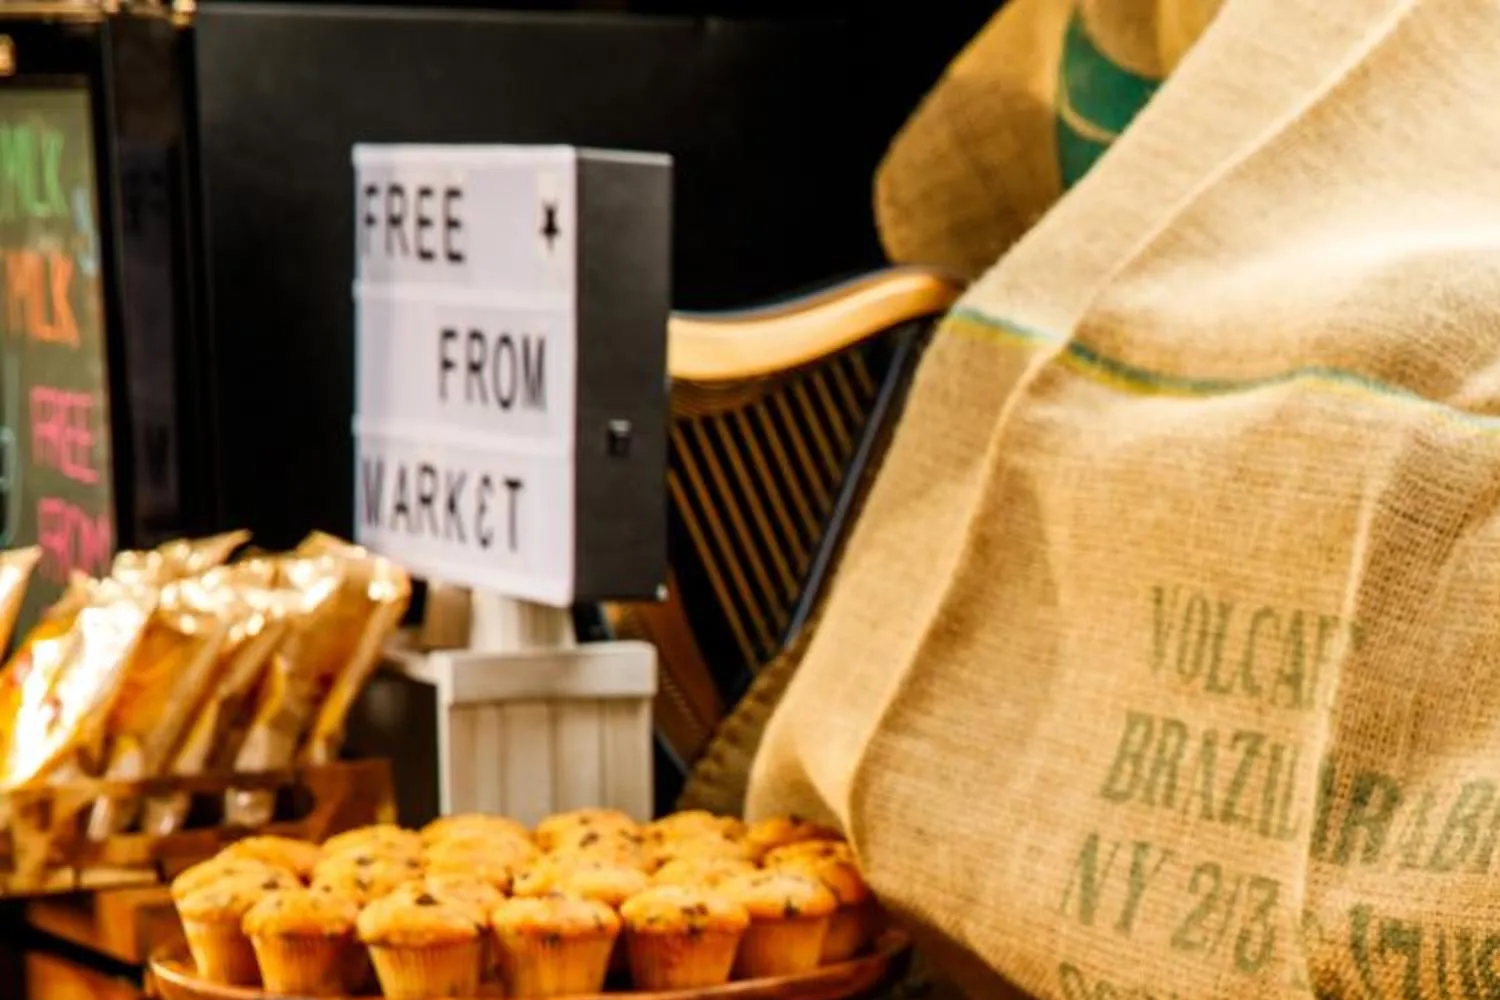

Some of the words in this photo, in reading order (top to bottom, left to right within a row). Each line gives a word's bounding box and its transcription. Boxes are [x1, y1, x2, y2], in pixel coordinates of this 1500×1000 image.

[361, 183, 466, 265] FREE
[437, 328, 548, 412] FROM
[360, 456, 524, 553] MARKET
[1148, 583, 1368, 712] VOLCAF
[1058, 832, 1174, 938] NY
